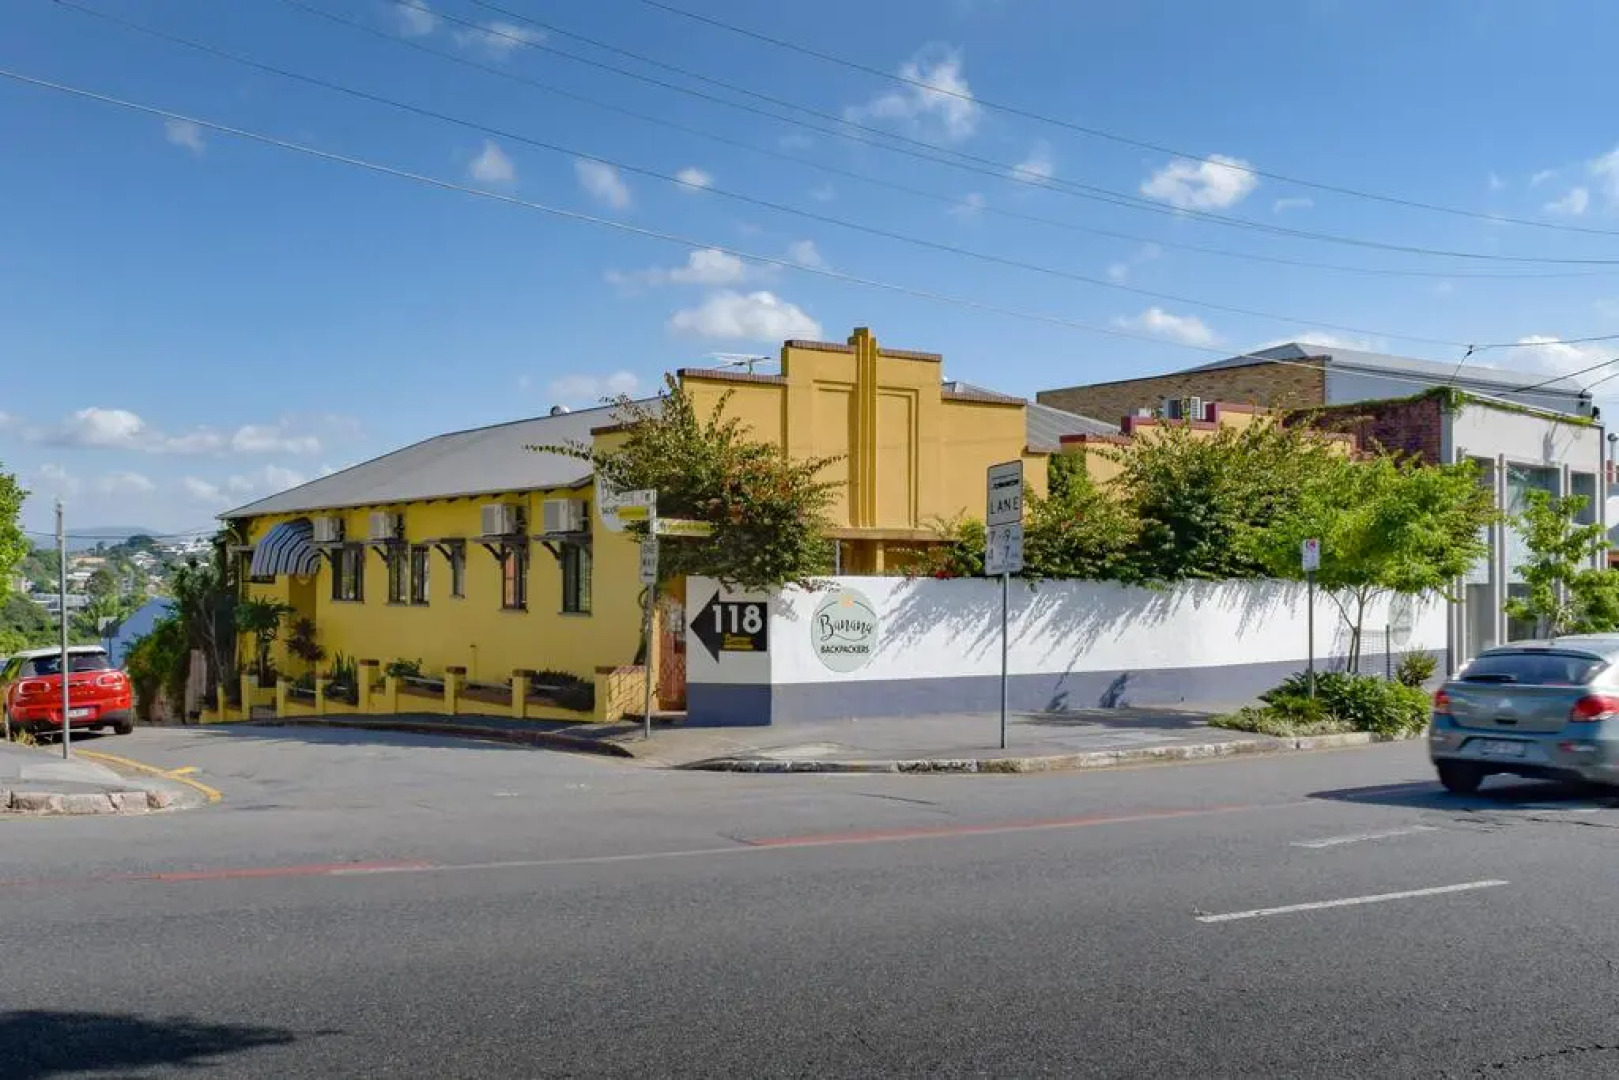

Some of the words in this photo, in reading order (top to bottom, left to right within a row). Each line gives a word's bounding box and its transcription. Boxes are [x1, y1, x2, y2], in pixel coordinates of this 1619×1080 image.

[990, 496, 1020, 514] LANE
[712, 605, 763, 634] 118
[818, 614, 873, 641] Banana
[821, 644, 869, 654] BACKPACKERS
